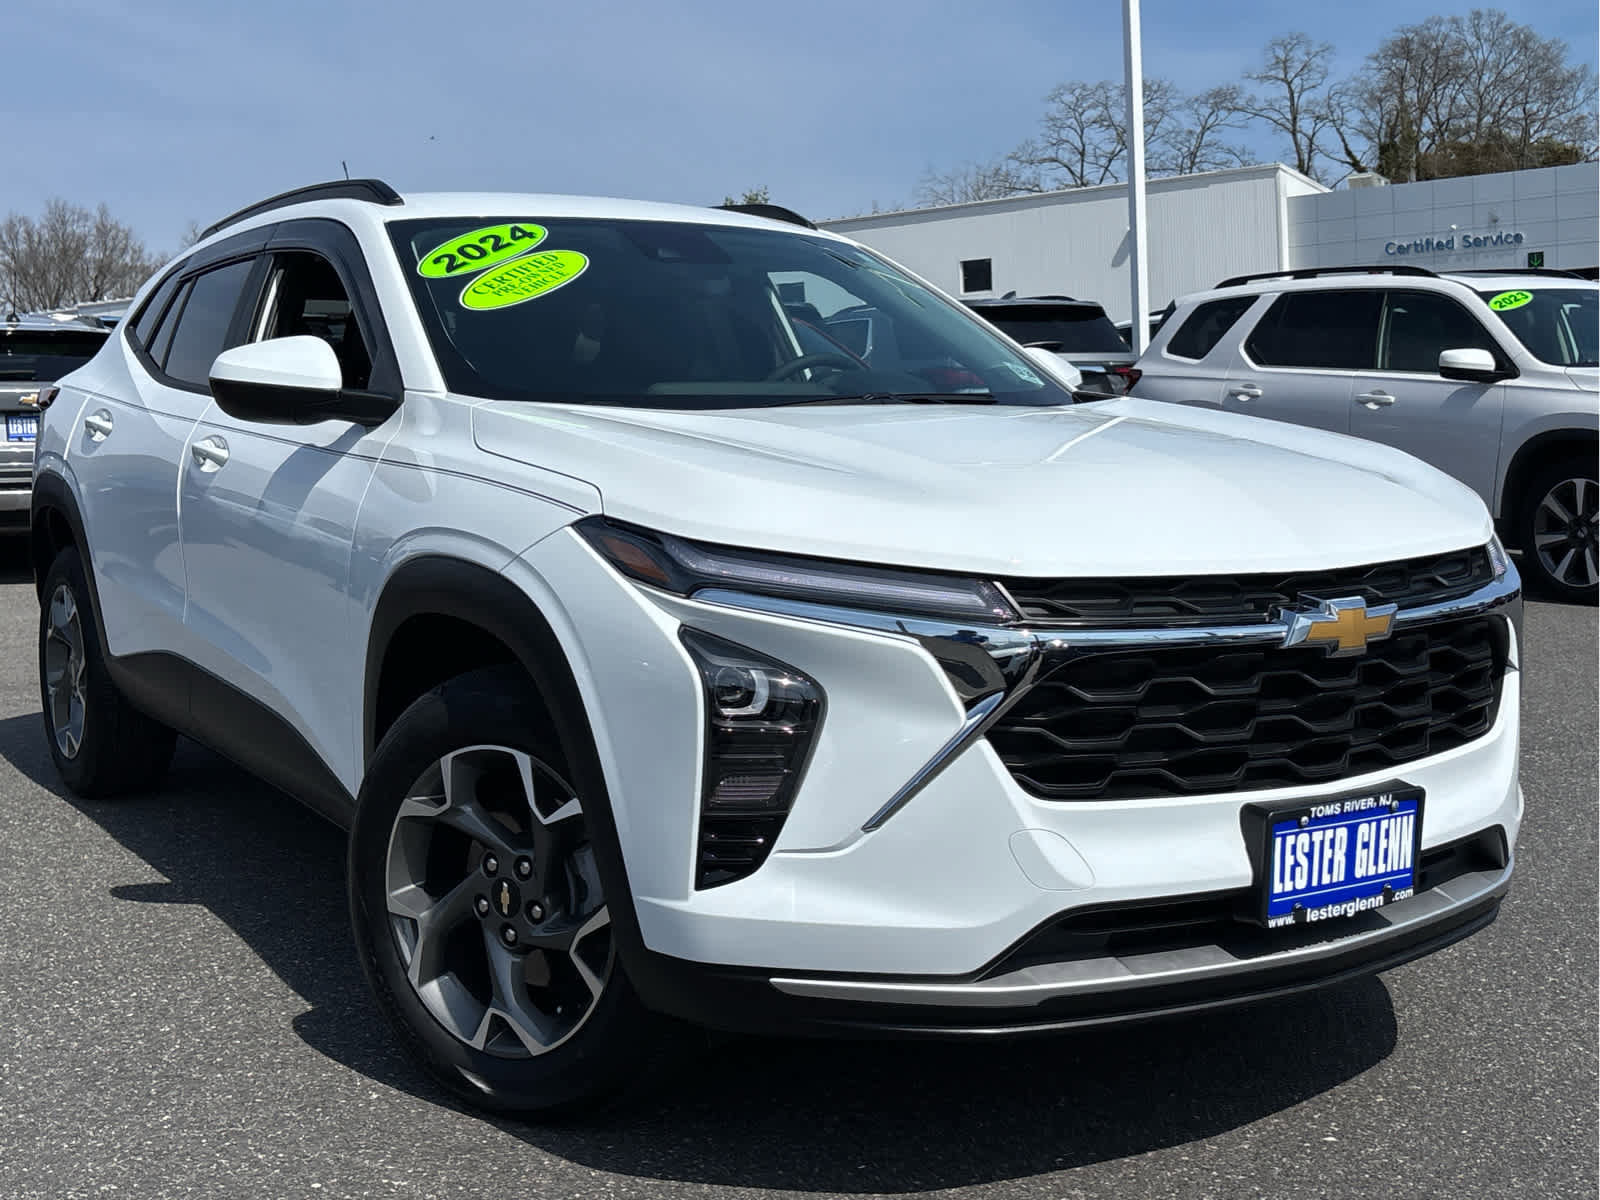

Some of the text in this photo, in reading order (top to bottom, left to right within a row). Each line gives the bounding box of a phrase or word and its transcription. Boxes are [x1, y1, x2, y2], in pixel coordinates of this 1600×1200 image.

[433, 225, 537, 273] 2024
[1385, 232, 1524, 256] Certified Service
[472, 254, 559, 295] CERTIFIED
[512, 271, 570, 296] VEHICLE
[1494, 292, 1529, 309] 2023
[1310, 794, 1393, 819] TOMS RIVER, NJ
[1273, 814, 1415, 894] LESTER GLENN
[1306, 894, 1384, 922] lesterglenn
